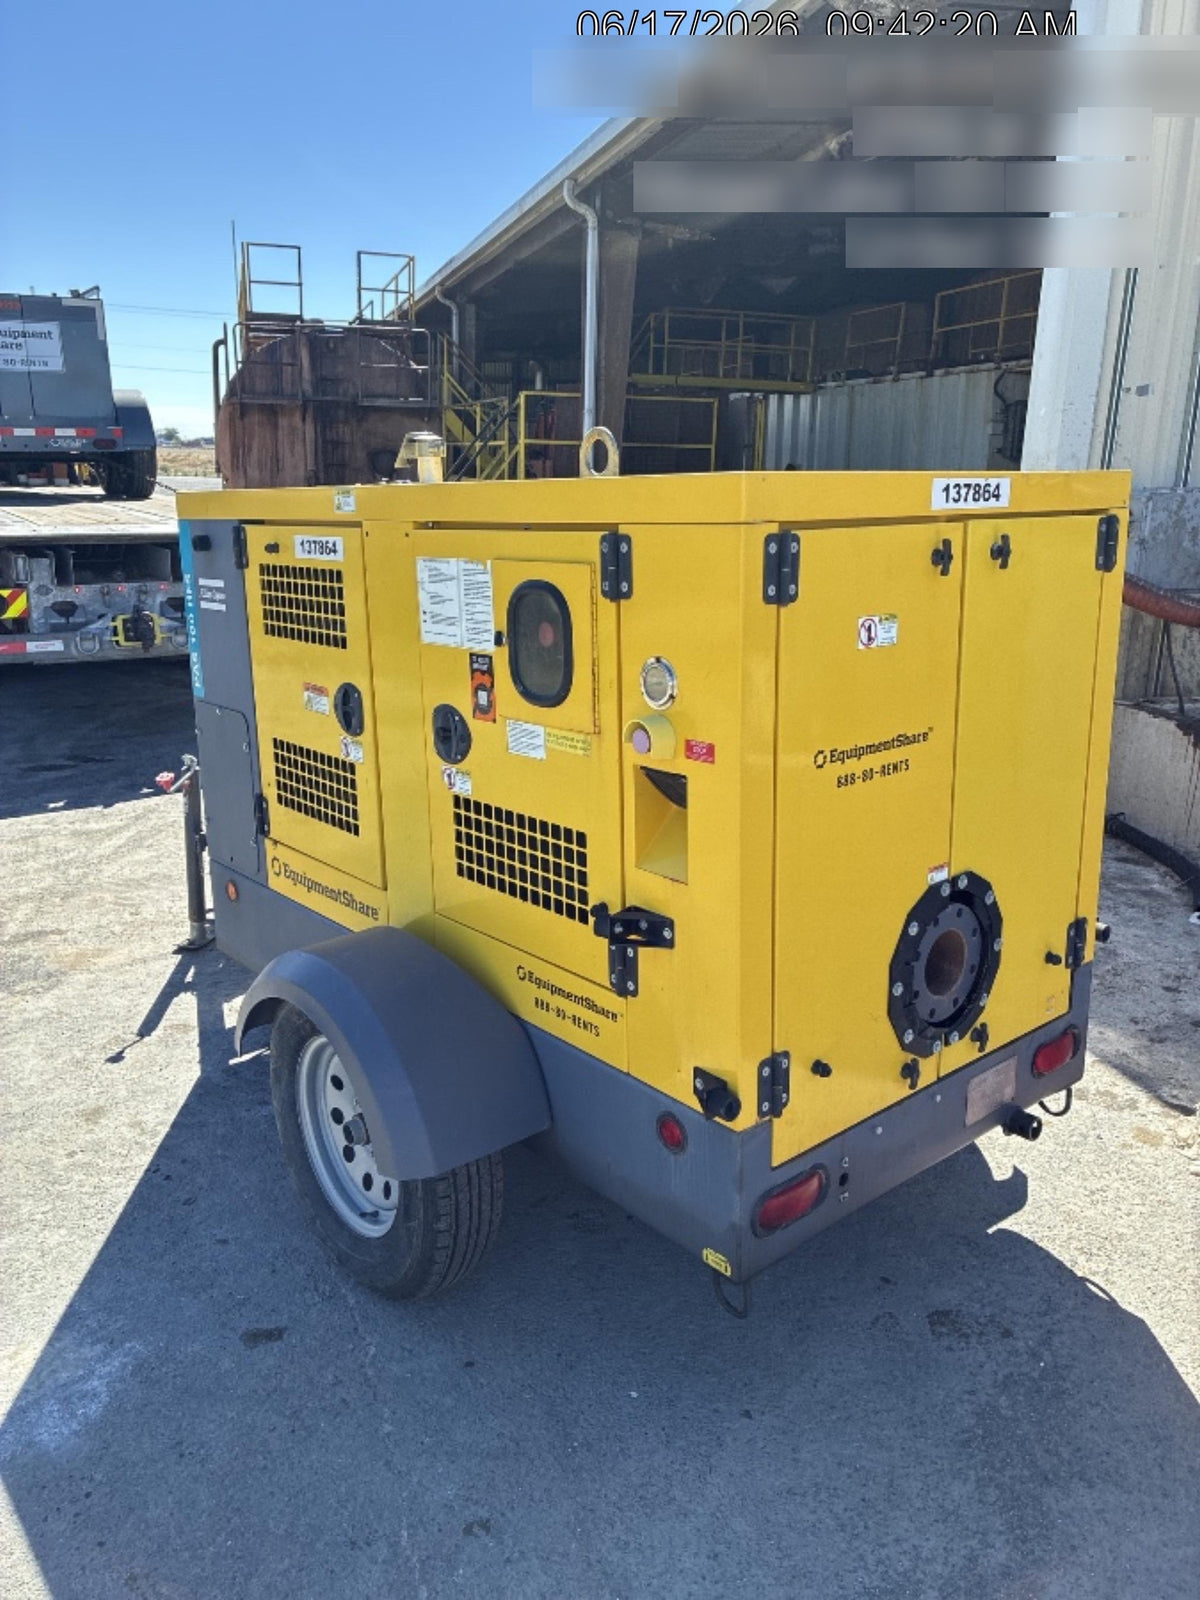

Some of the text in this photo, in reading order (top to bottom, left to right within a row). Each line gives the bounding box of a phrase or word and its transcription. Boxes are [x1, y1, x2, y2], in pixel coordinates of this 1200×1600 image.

[942, 482, 1002, 504] 137864
[299, 538, 338, 556] 137864
[829, 731, 929, 765] EquipmentShare
[836, 758, 910, 789] 888-80-RENTS
[282, 861, 380, 921] EquipmentShare
[527, 970, 618, 1023] EquipmentShare
[533, 996, 601, 1038] 888-80-RENTS
